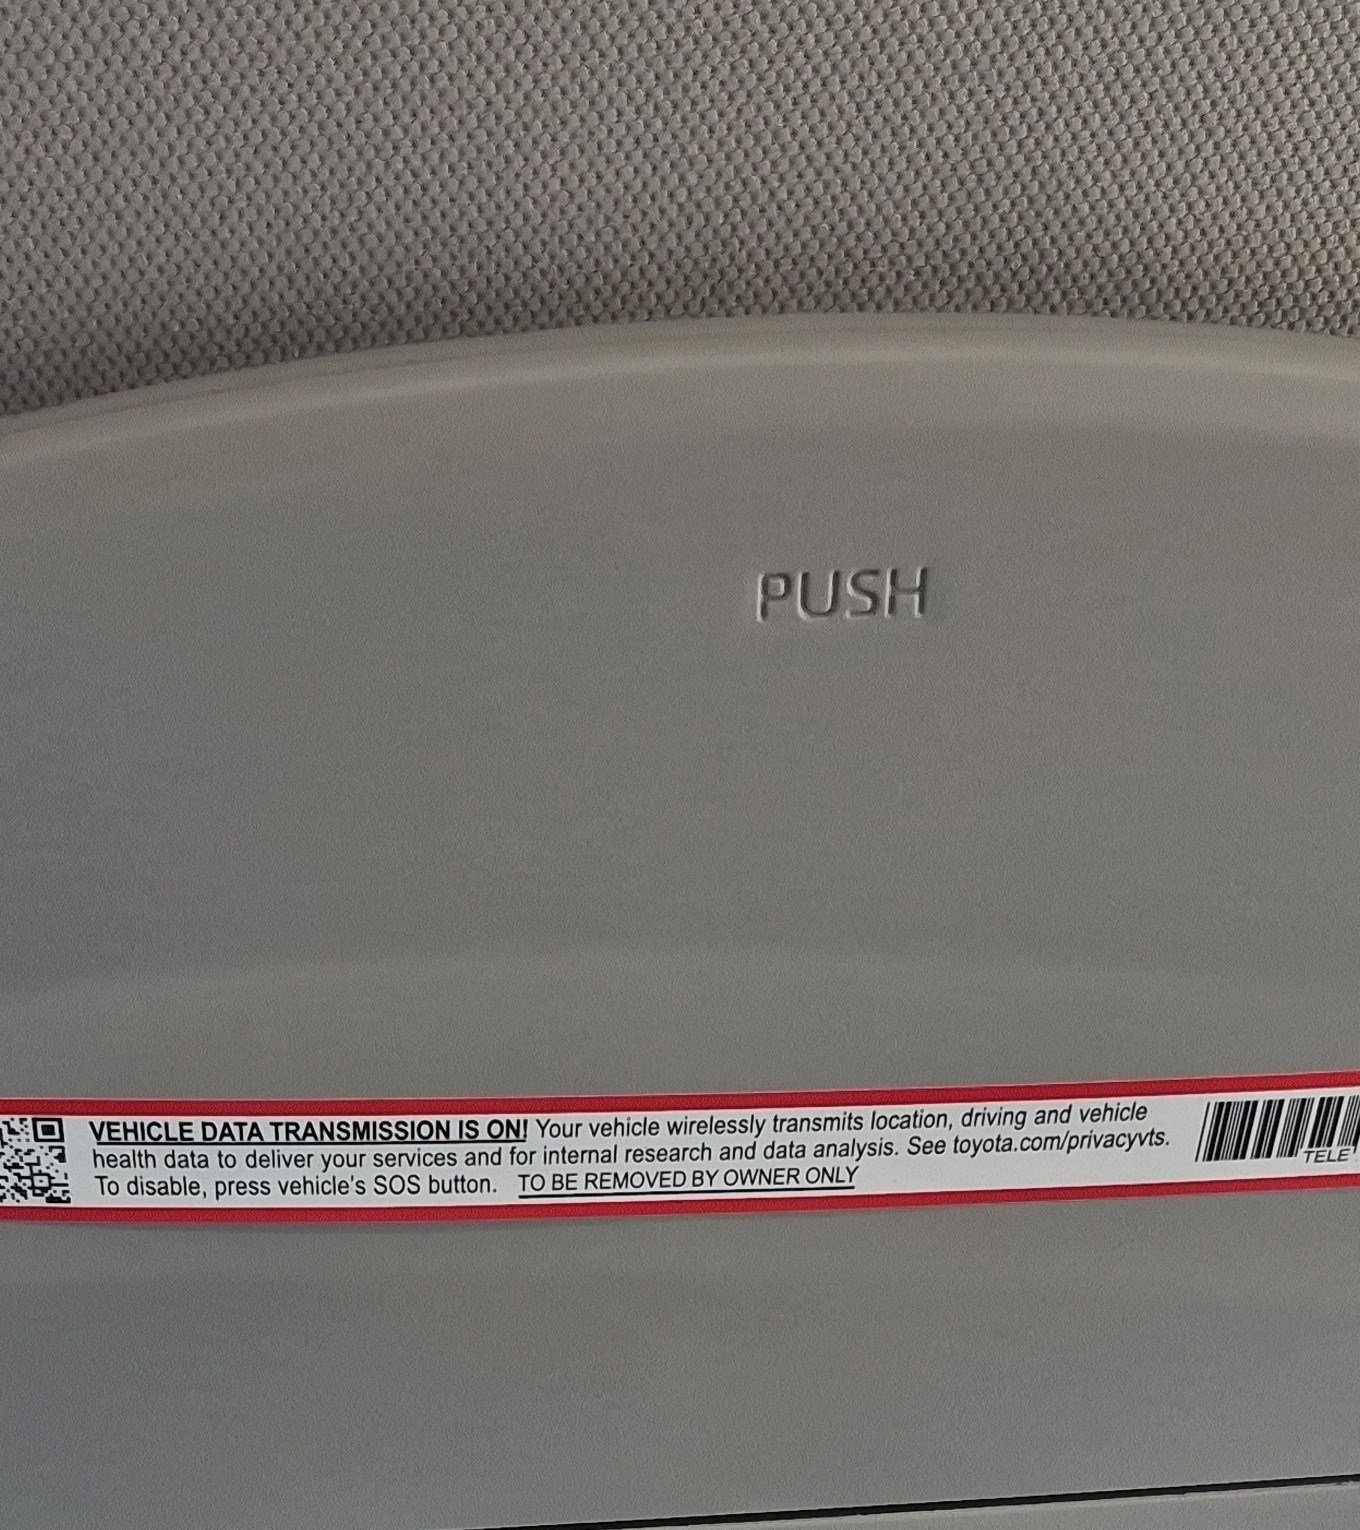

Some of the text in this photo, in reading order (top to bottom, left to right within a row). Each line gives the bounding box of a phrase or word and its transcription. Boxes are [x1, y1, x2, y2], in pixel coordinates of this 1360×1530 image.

[756, 566, 928, 623] PUSH
[89, 1101, 1148, 1142] VEHICLE DATA TRANSMISSION IS ON! Your vehicle wirelessly transmits location, driving and vehicle
[92, 1128, 1170, 1173] health data to deliver your services and for internal research and data analysis. See toyota.com/privacyvts.
[1303, 1147, 1350, 1164] TELE
[94, 1165, 859, 1200] To disable, press vehicle's SOS button. TO BE REMOVED BY OWNER ONLY
